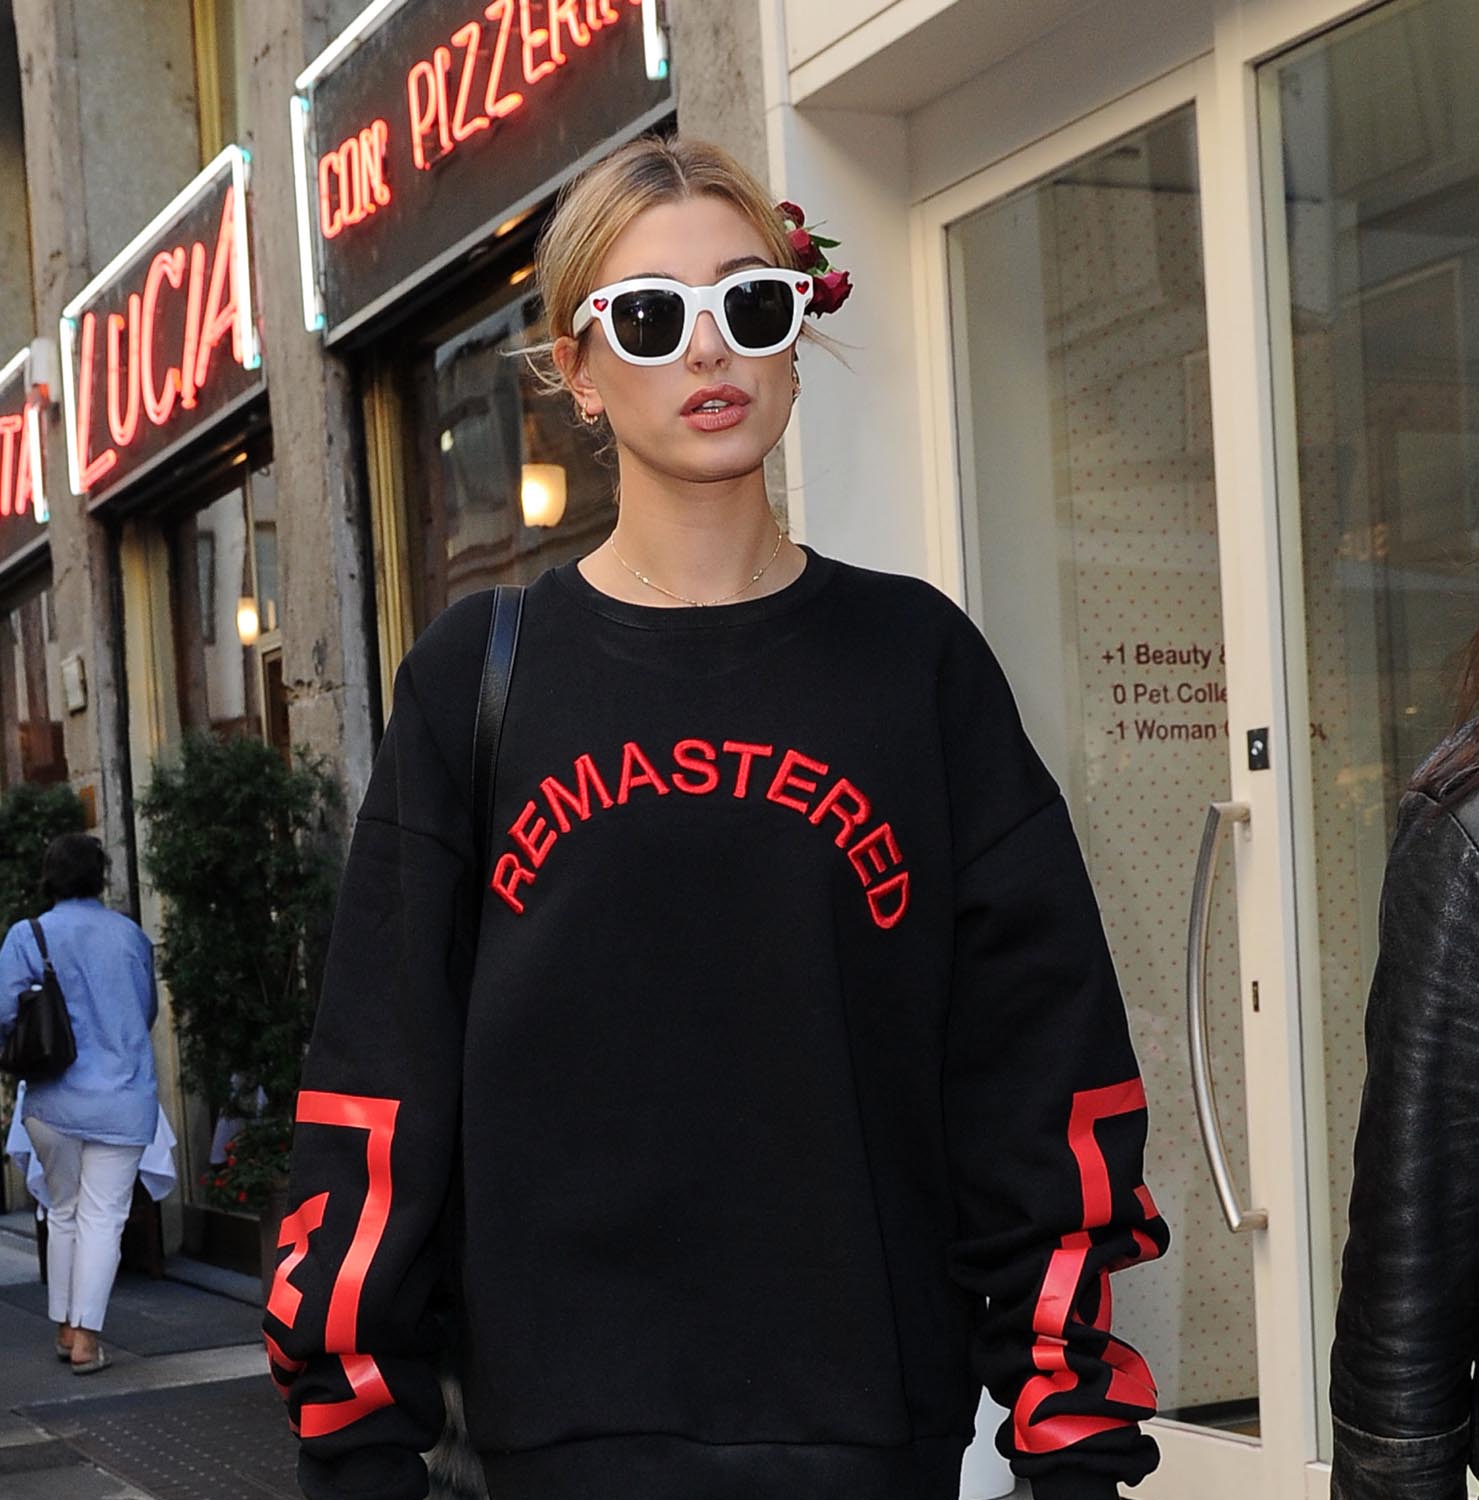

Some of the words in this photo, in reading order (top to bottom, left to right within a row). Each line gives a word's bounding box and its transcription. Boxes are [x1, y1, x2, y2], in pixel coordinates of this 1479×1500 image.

[407, 0, 642, 170] PIZZER
[77, 186, 244, 493] LUCIA
[1101, 643, 1126, 666] +1
[1135, 643, 1212, 670] Beauty
[1112, 684, 1127, 705] 0
[1134, 683, 1169, 705] Pet
[1105, 720, 1126, 741] -1
[1133, 719, 1217, 741] Woman
[490, 738, 910, 930] REMASTERED
